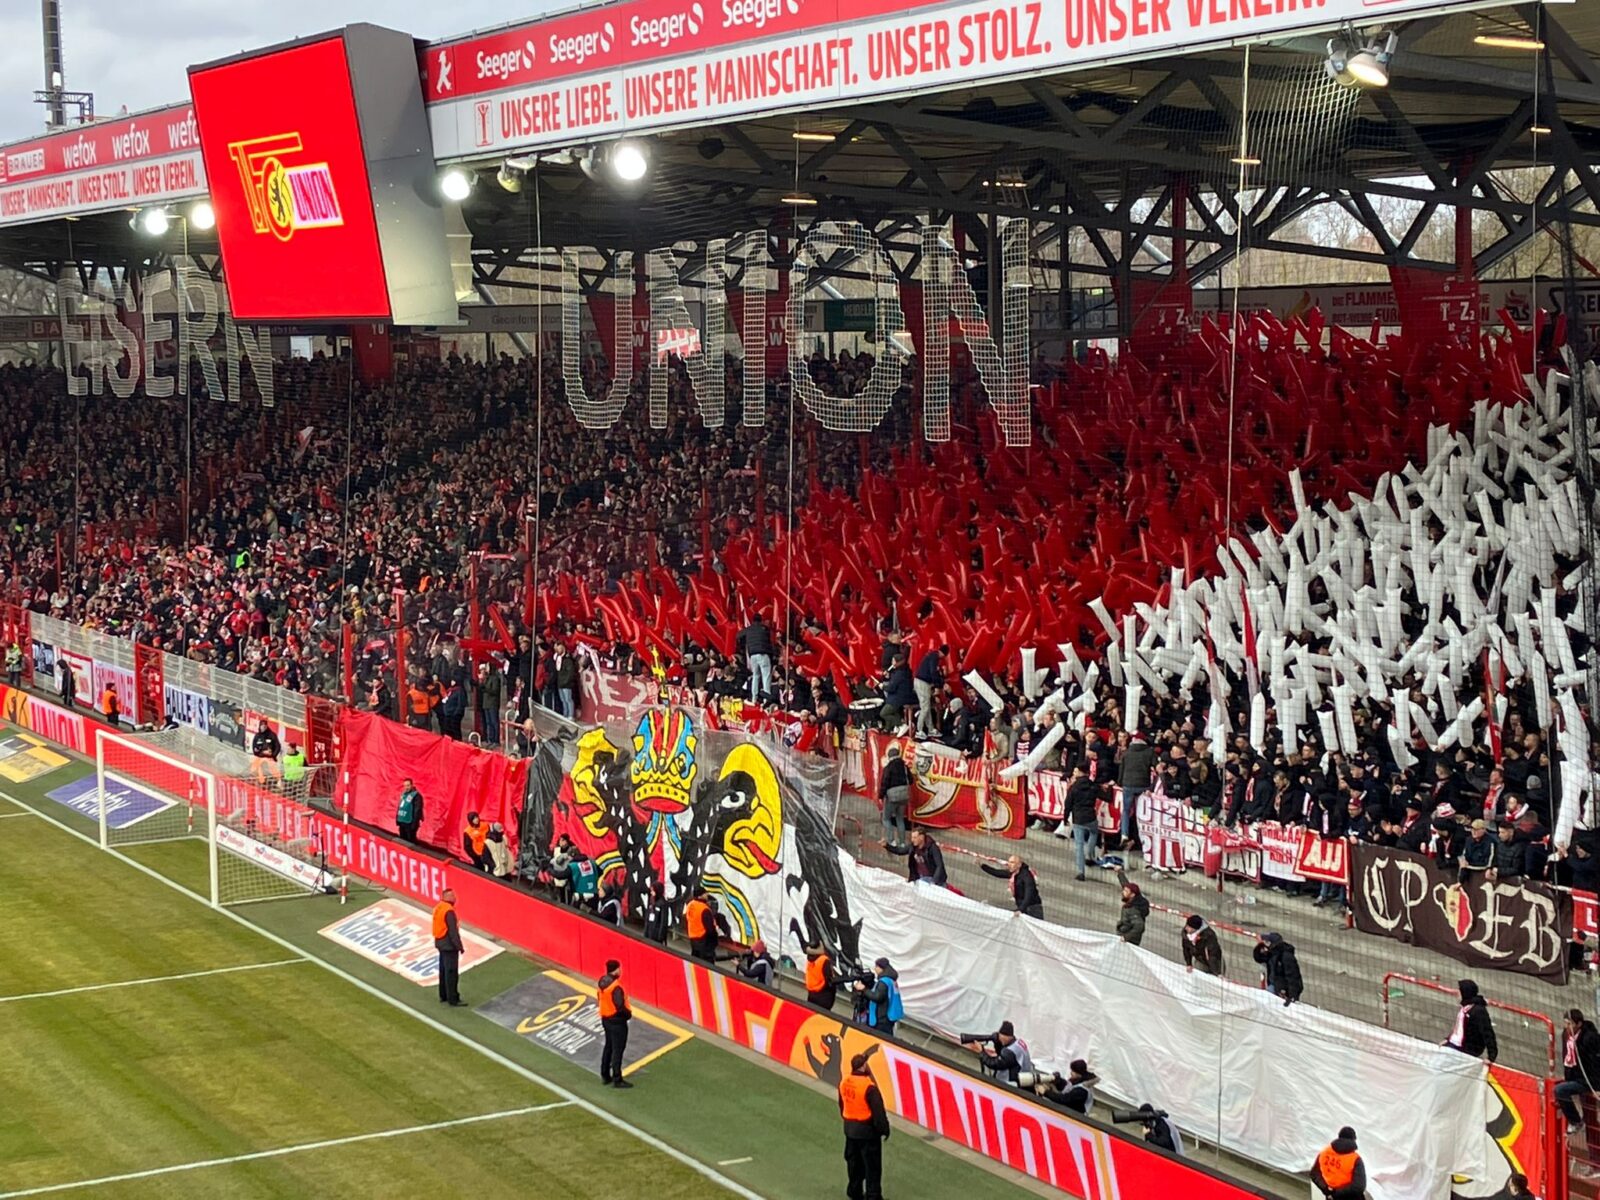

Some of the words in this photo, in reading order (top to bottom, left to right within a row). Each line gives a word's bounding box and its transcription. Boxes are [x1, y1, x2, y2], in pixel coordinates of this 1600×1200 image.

[630, 12, 687, 47] Seeger
[721, 0, 783, 28] Seeger
[476, 48, 521, 80] Seeger
[550, 29, 608, 64] Seeger
[501, 95, 561, 139] UNSERE
[566, 81, 619, 129] LIEBE.
[625, 66, 698, 118] UNSERE
[705, 37, 859, 107] MANNSCHAFT.
[868, 20, 951, 81] UNSER
[958, 2, 1052, 66] STOLZ.
[1064, 0, 1172, 48] UNSER
[62, 134, 98, 169] wefox
[112, 122, 151, 160] wefox
[8, 152, 44, 174] BRAUER
[77, 175, 103, 204] UNSER
[132, 165, 161, 196] UNSER
[163, 158, 199, 192] VEREIN.
[288, 169, 339, 222] UNION
[561, 217, 1032, 447] UNION
[30, 702, 80, 753] UNION
[360, 833, 447, 902] FÖRSTEREI
[894, 1057, 1101, 1200] UNION
